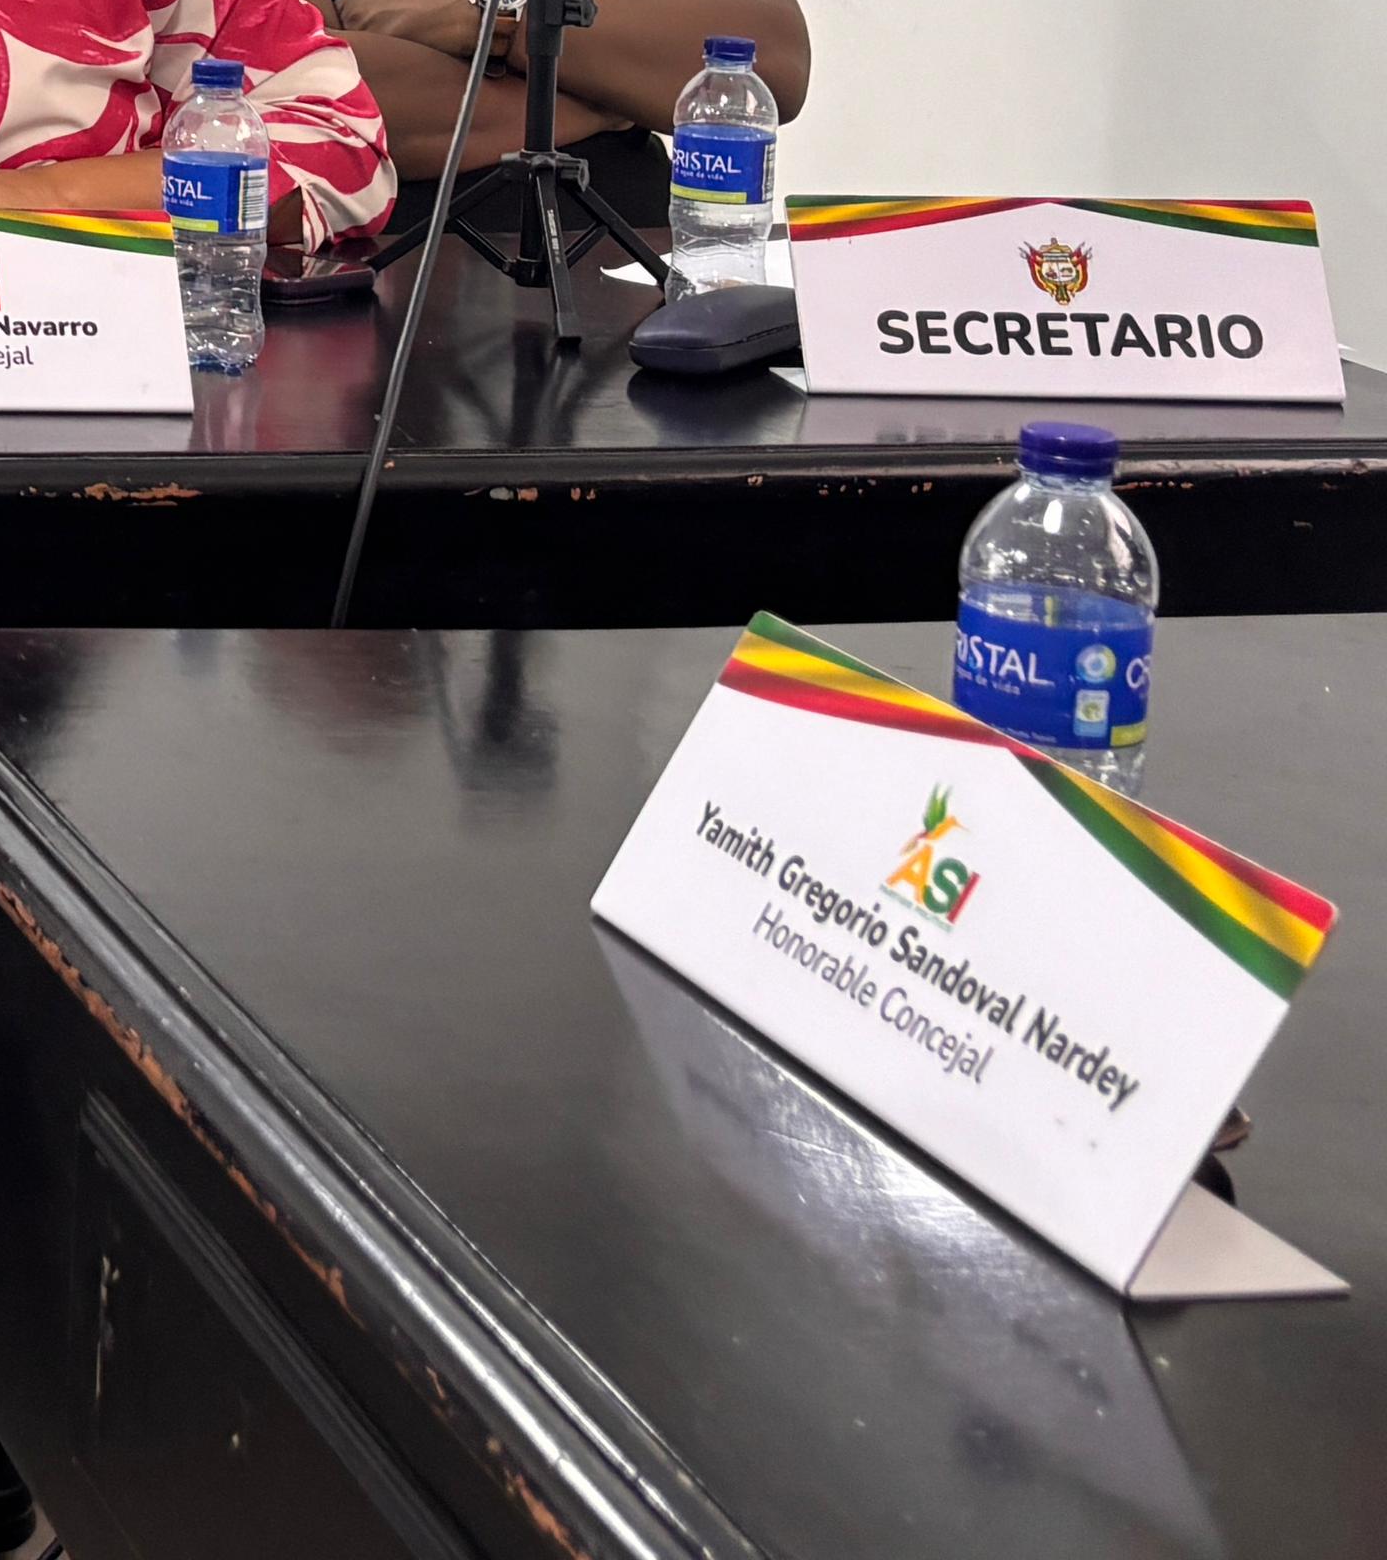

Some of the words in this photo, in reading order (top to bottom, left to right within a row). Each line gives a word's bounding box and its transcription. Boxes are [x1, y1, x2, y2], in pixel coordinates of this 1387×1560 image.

[877, 309, 1264, 360] SECRETARIO
[885, 843, 981, 925] ASI
[696, 799, 775, 877] Yamith
[778, 854, 888, 947] Gregorio
[890, 925, 1026, 1034] Sandoval
[1022, 1006, 1140, 1113] Nardey
[752, 901, 878, 1006] Honorable
[879, 986, 994, 1085] Concejal
